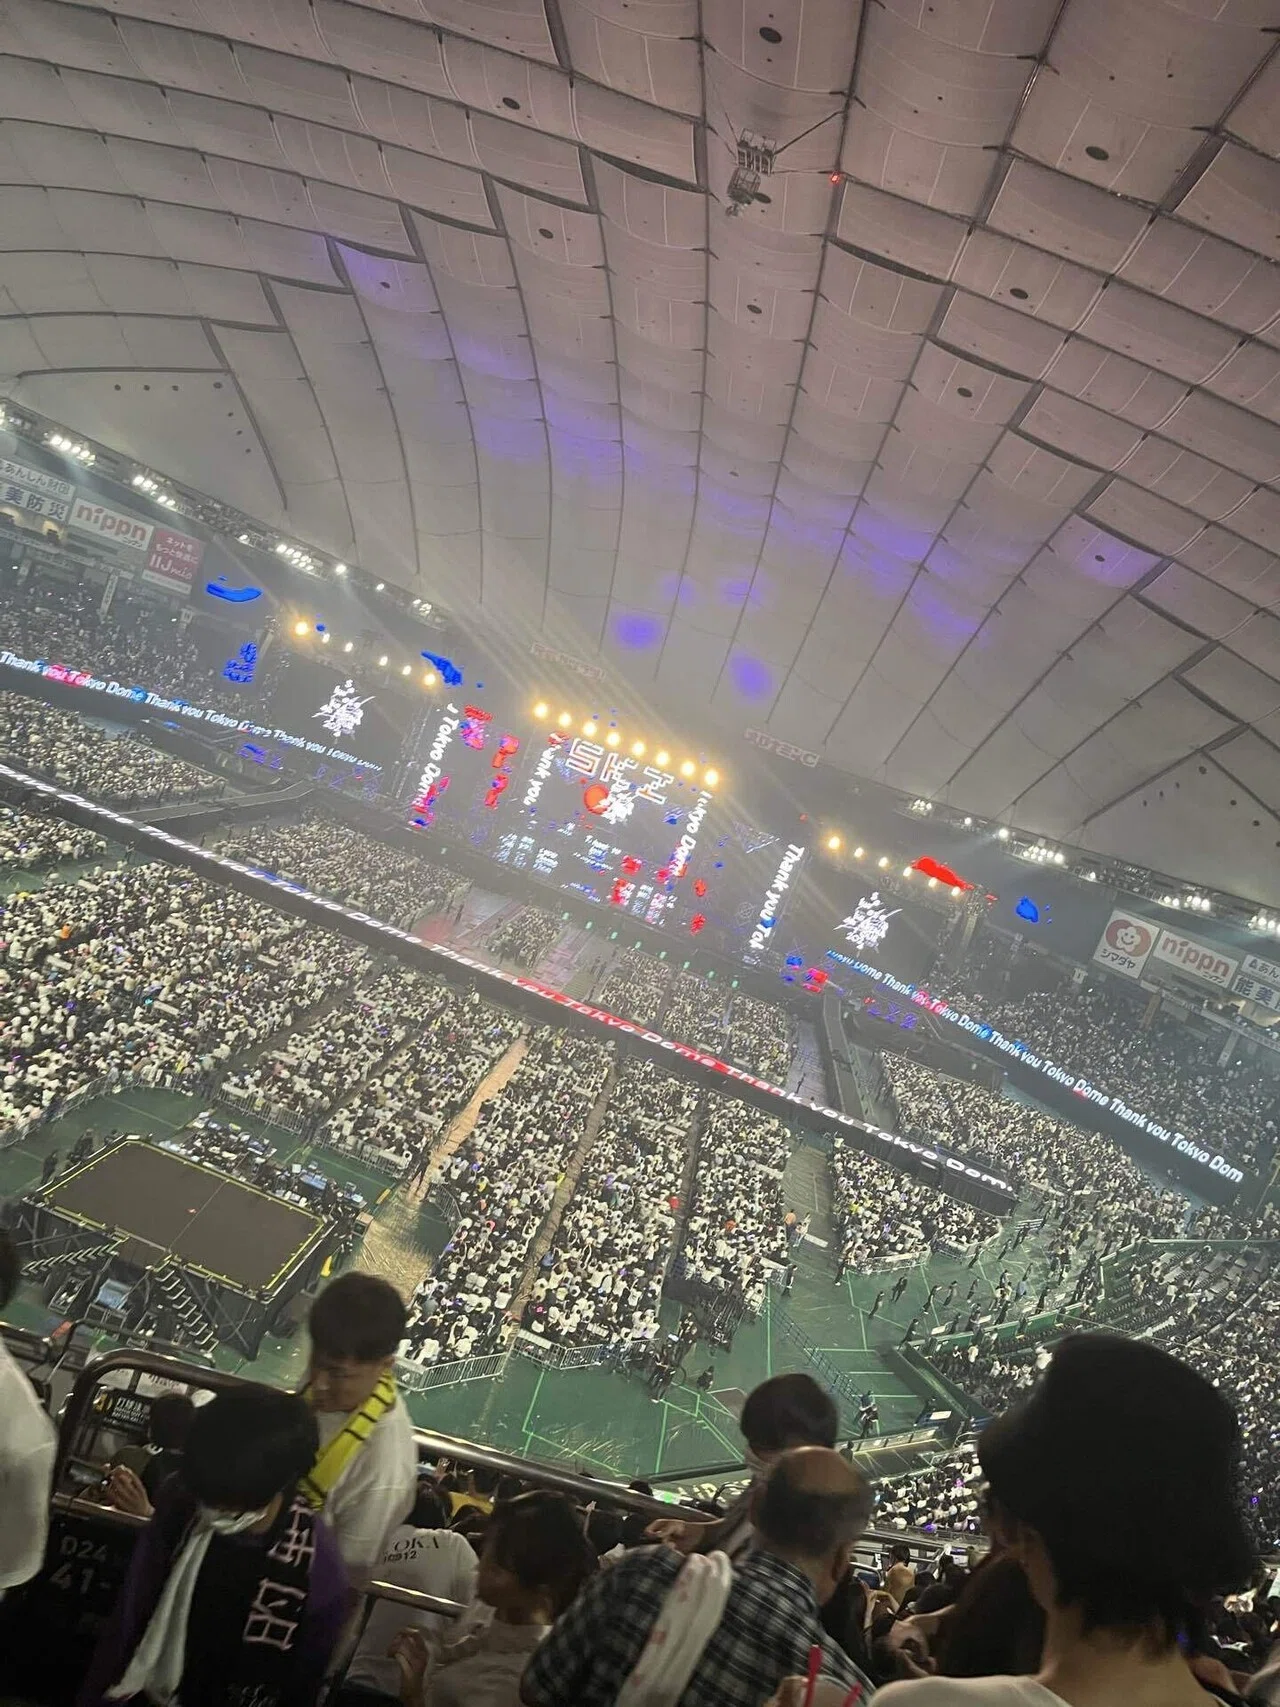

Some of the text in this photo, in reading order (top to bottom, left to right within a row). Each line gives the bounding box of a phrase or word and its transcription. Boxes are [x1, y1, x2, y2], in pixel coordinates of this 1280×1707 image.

[76, 503, 147, 542] nippn
[182, 704, 205, 719] you
[523, 778, 544, 806] you
[772, 844, 806, 892] Thank
[759, 890, 781, 921] you
[1100, 948, 1137, 970] シマダヤ
[1162, 936, 1230, 978] nippn
[348, 912, 423, 945] Dome
[430, 943, 506, 979] Thank
[511, 977, 556, 999] you
[563, 1000, 636, 1033] Tokyo
[810, 1102, 854, 1126] you
[862, 1122, 939, 1160] Tokyo
[989, 1030, 1022, 1059] Thank
[1020, 1050, 1042, 1069] you
[1042, 1060, 1075, 1087] Tokyo
[1109, 1098, 1148, 1129] Thank
[1146, 1121, 1171, 1142] you
[1171, 1133, 1211, 1164] Tokyo
